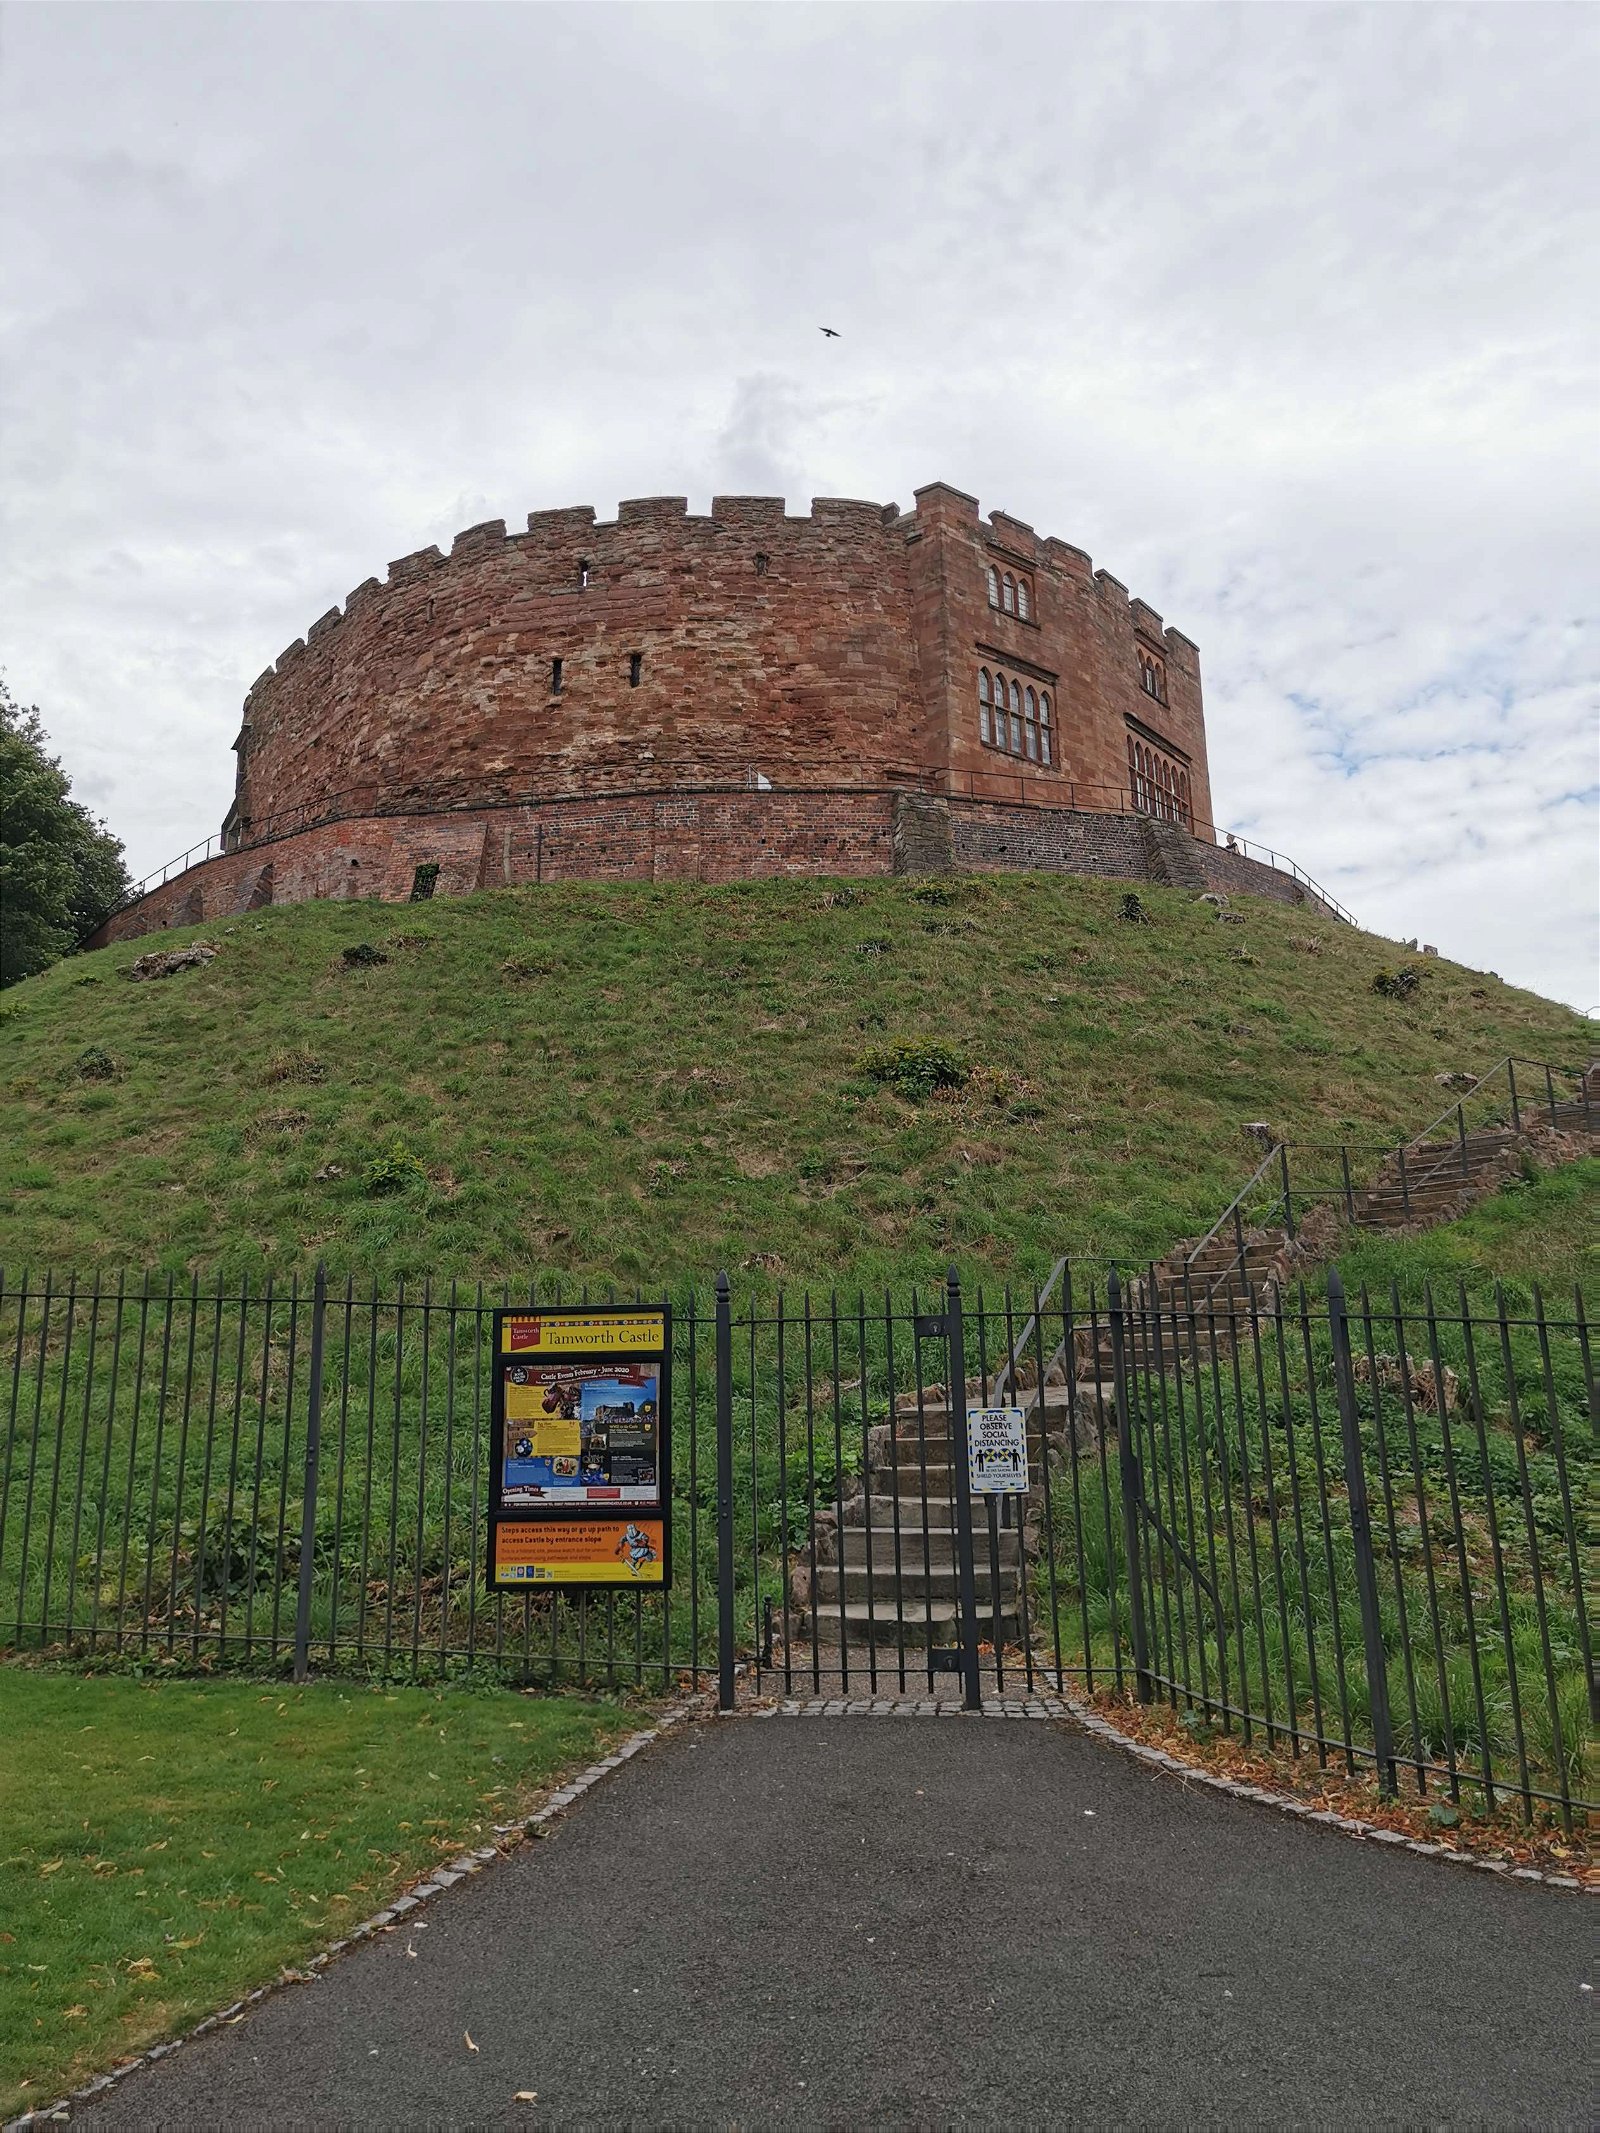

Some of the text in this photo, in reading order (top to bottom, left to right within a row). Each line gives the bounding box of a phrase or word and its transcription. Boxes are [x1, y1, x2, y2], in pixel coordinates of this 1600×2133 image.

[513, 1327, 540, 1335] Tamworth
[546, 1328, 660, 1345] Tamworth Castle
[557, 1372, 574, 1380] Events
[574, 1368, 598, 1377] February
[601, 1366, 614, 1374] June
[981, 1414, 1007, 1422] PLEASE
[979, 1422, 1012, 1431] OBSERVE
[982, 1431, 1009, 1439] SOCIAL
[974, 1438, 1020, 1448] DISTANCING
[502, 1487, 524, 1496] Opening
[501, 1526, 520, 1535] Steps
[557, 1527, 570, 1535] way
[579, 1527, 588, 1535] go
[588, 1526, 597, 1535] up
[597, 1525, 613, 1534] path
[545, 1536, 555, 1545] by
[555, 1535, 585, 1543] entrance
[584, 1535, 602, 1544] slope
